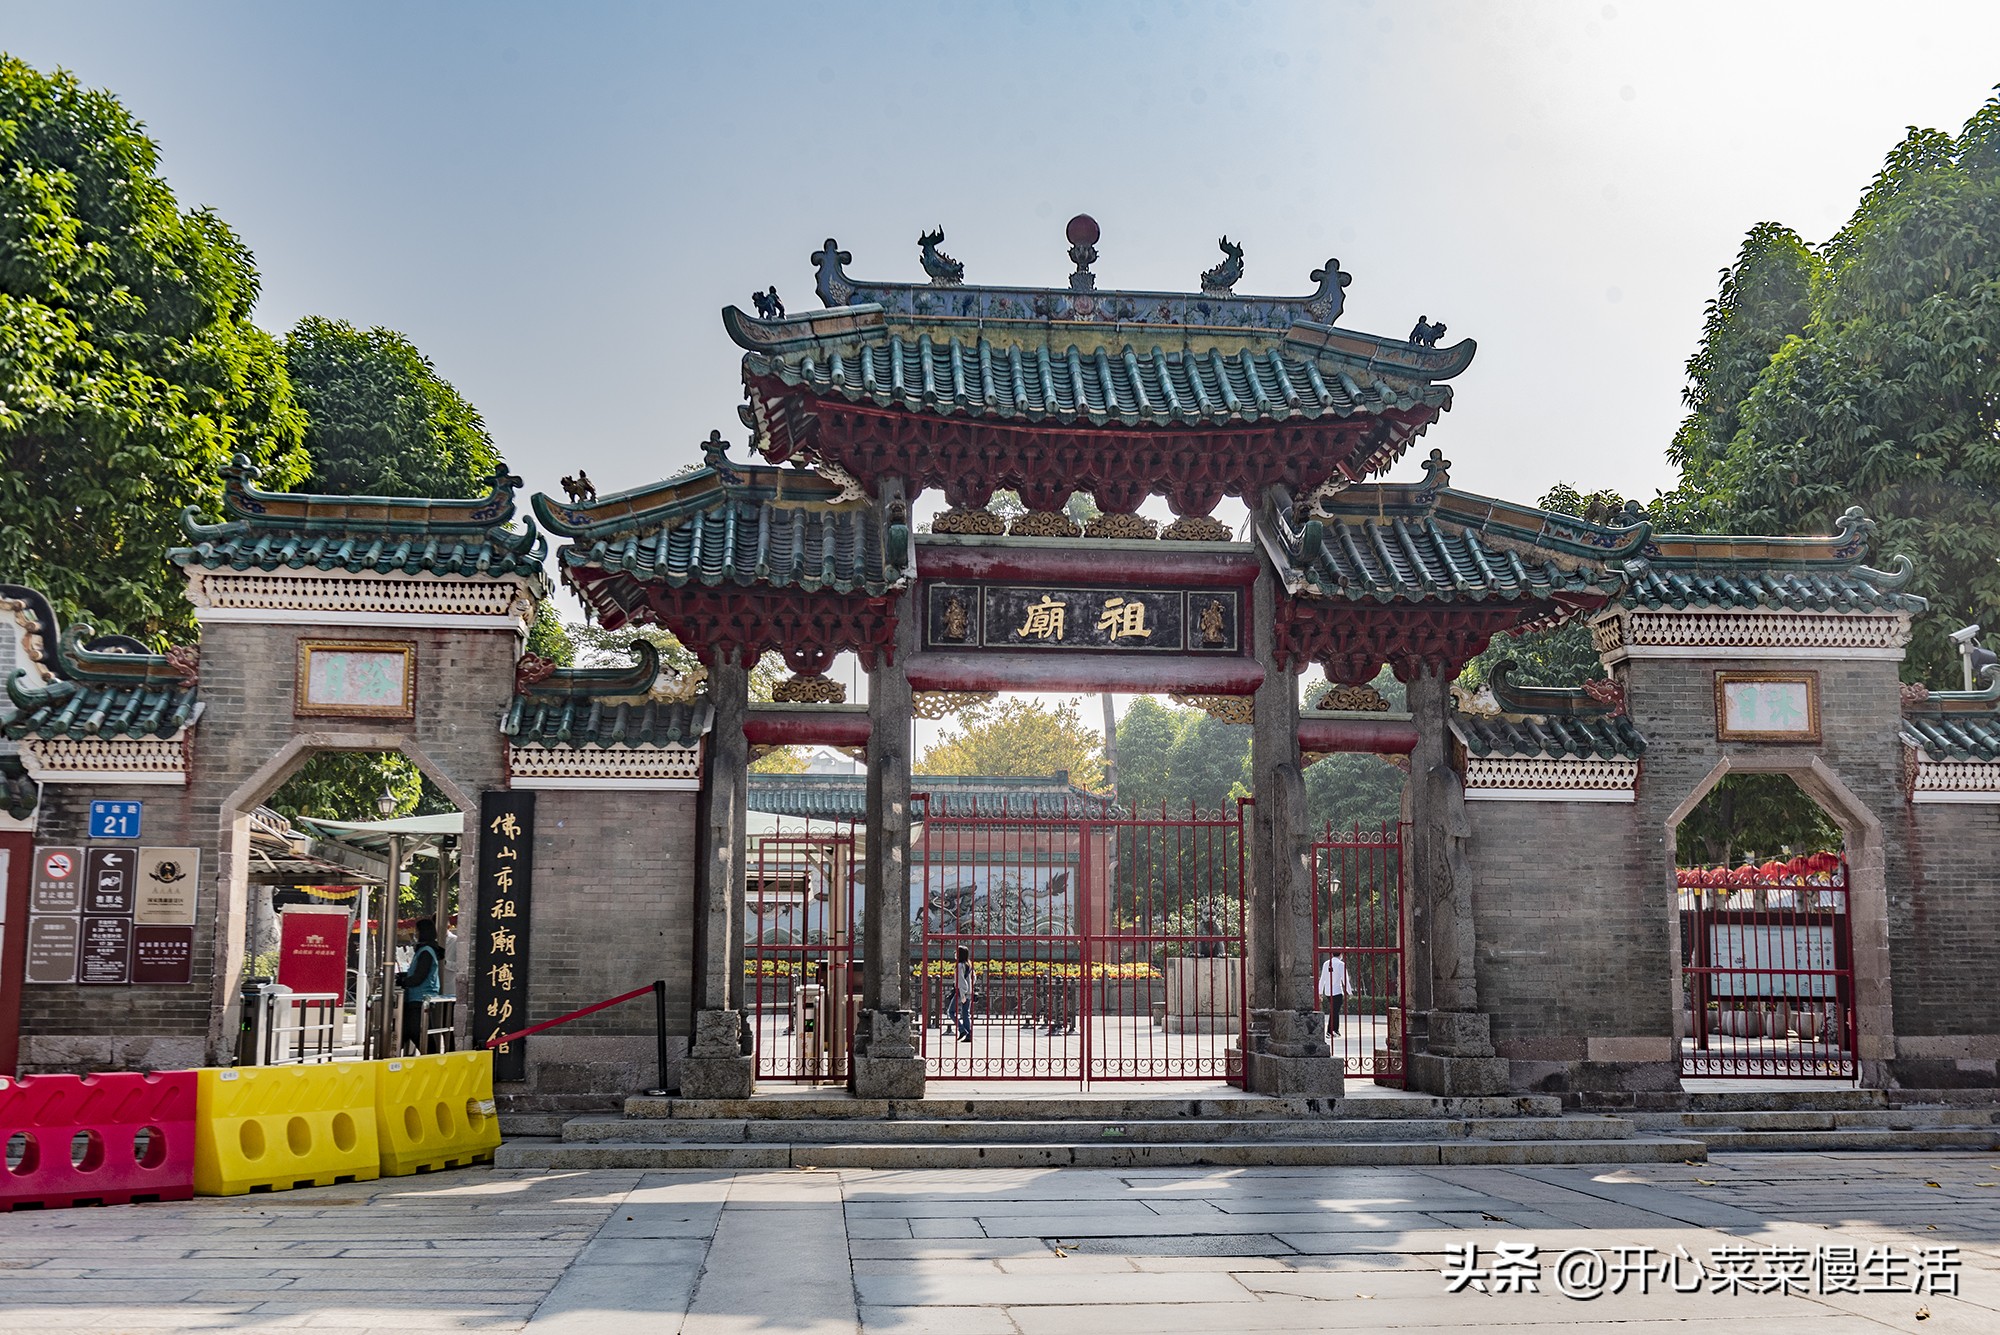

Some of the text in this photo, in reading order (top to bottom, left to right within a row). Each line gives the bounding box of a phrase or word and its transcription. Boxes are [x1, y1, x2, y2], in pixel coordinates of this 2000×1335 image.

[95, 804, 138, 814] 祖庙路
[103, 816, 127, 834] 21
